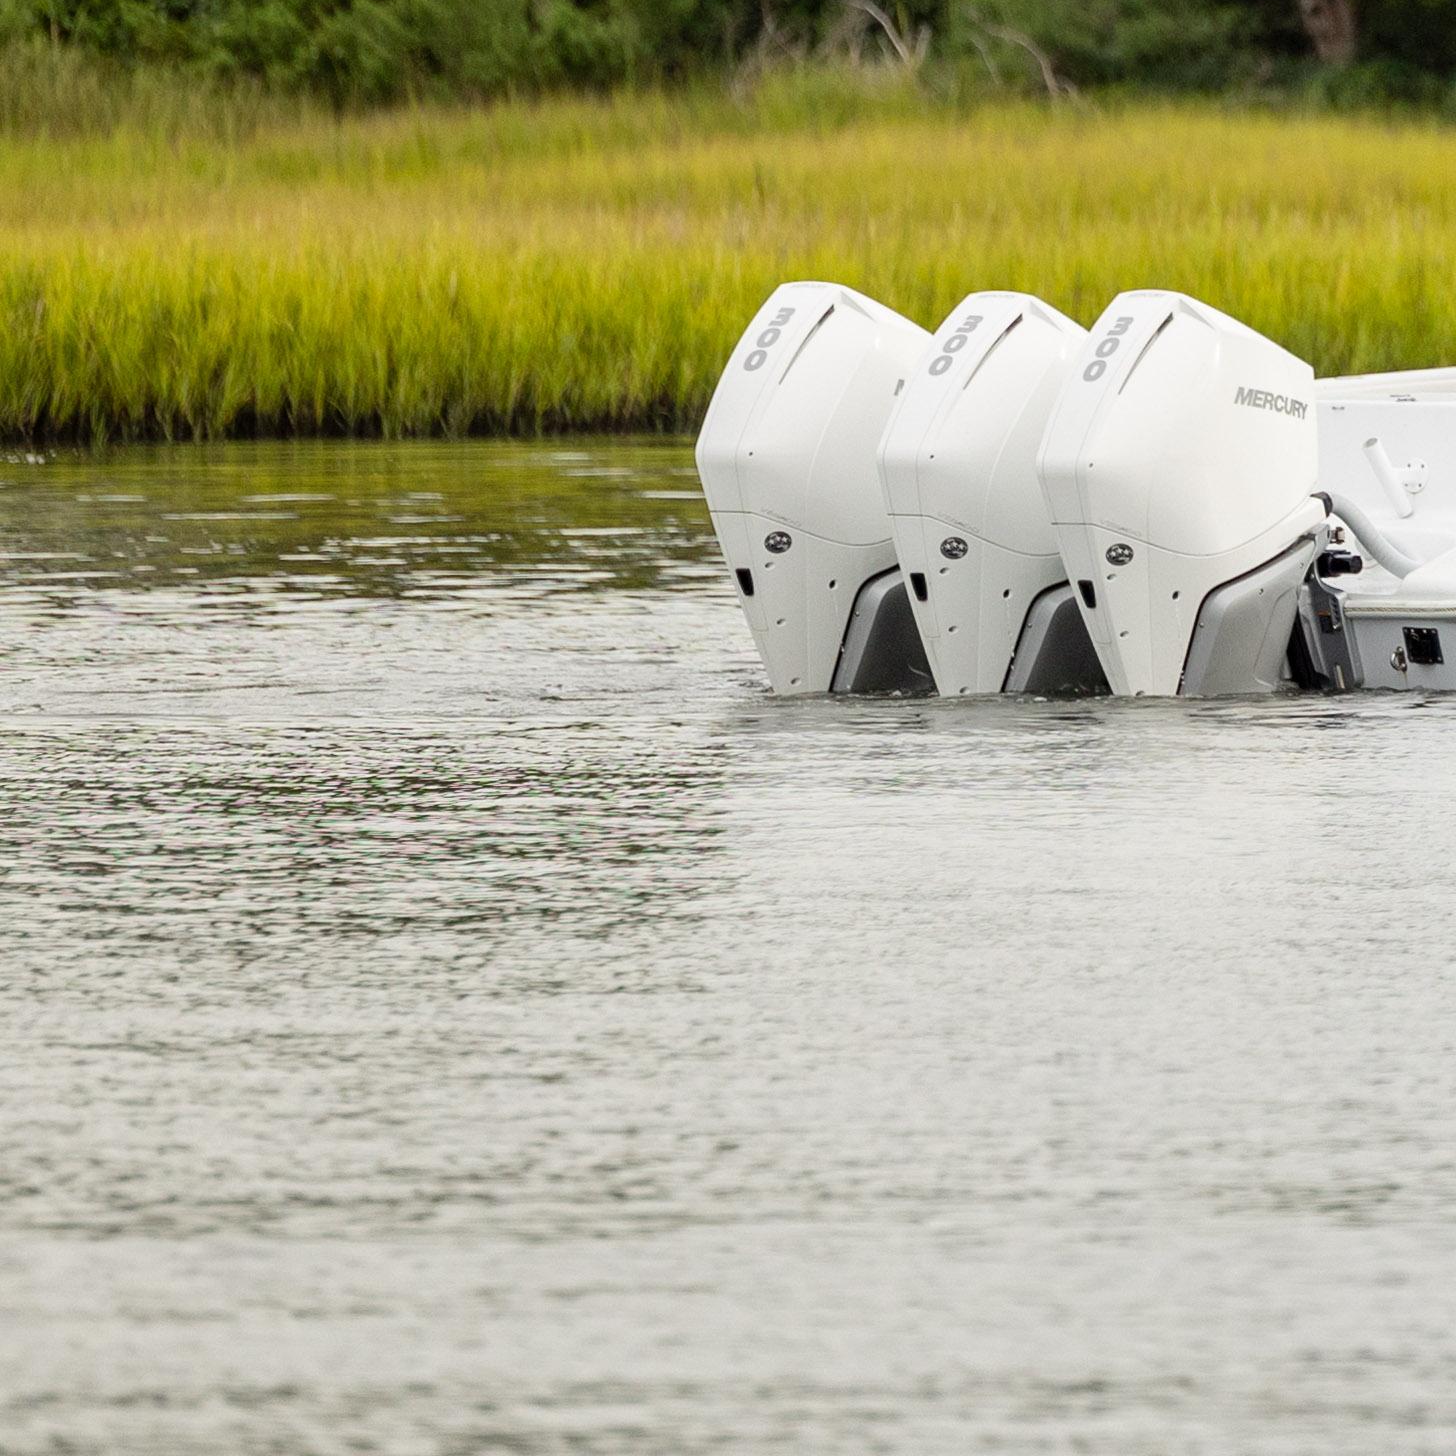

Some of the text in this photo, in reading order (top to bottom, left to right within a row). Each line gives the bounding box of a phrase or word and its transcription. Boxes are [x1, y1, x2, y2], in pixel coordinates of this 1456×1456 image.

[743, 307, 796, 372] 300
[928, 315, 984, 376] 300
[1082, 316, 1134, 382] 300
[1234, 387, 1308, 420] MERCURY
